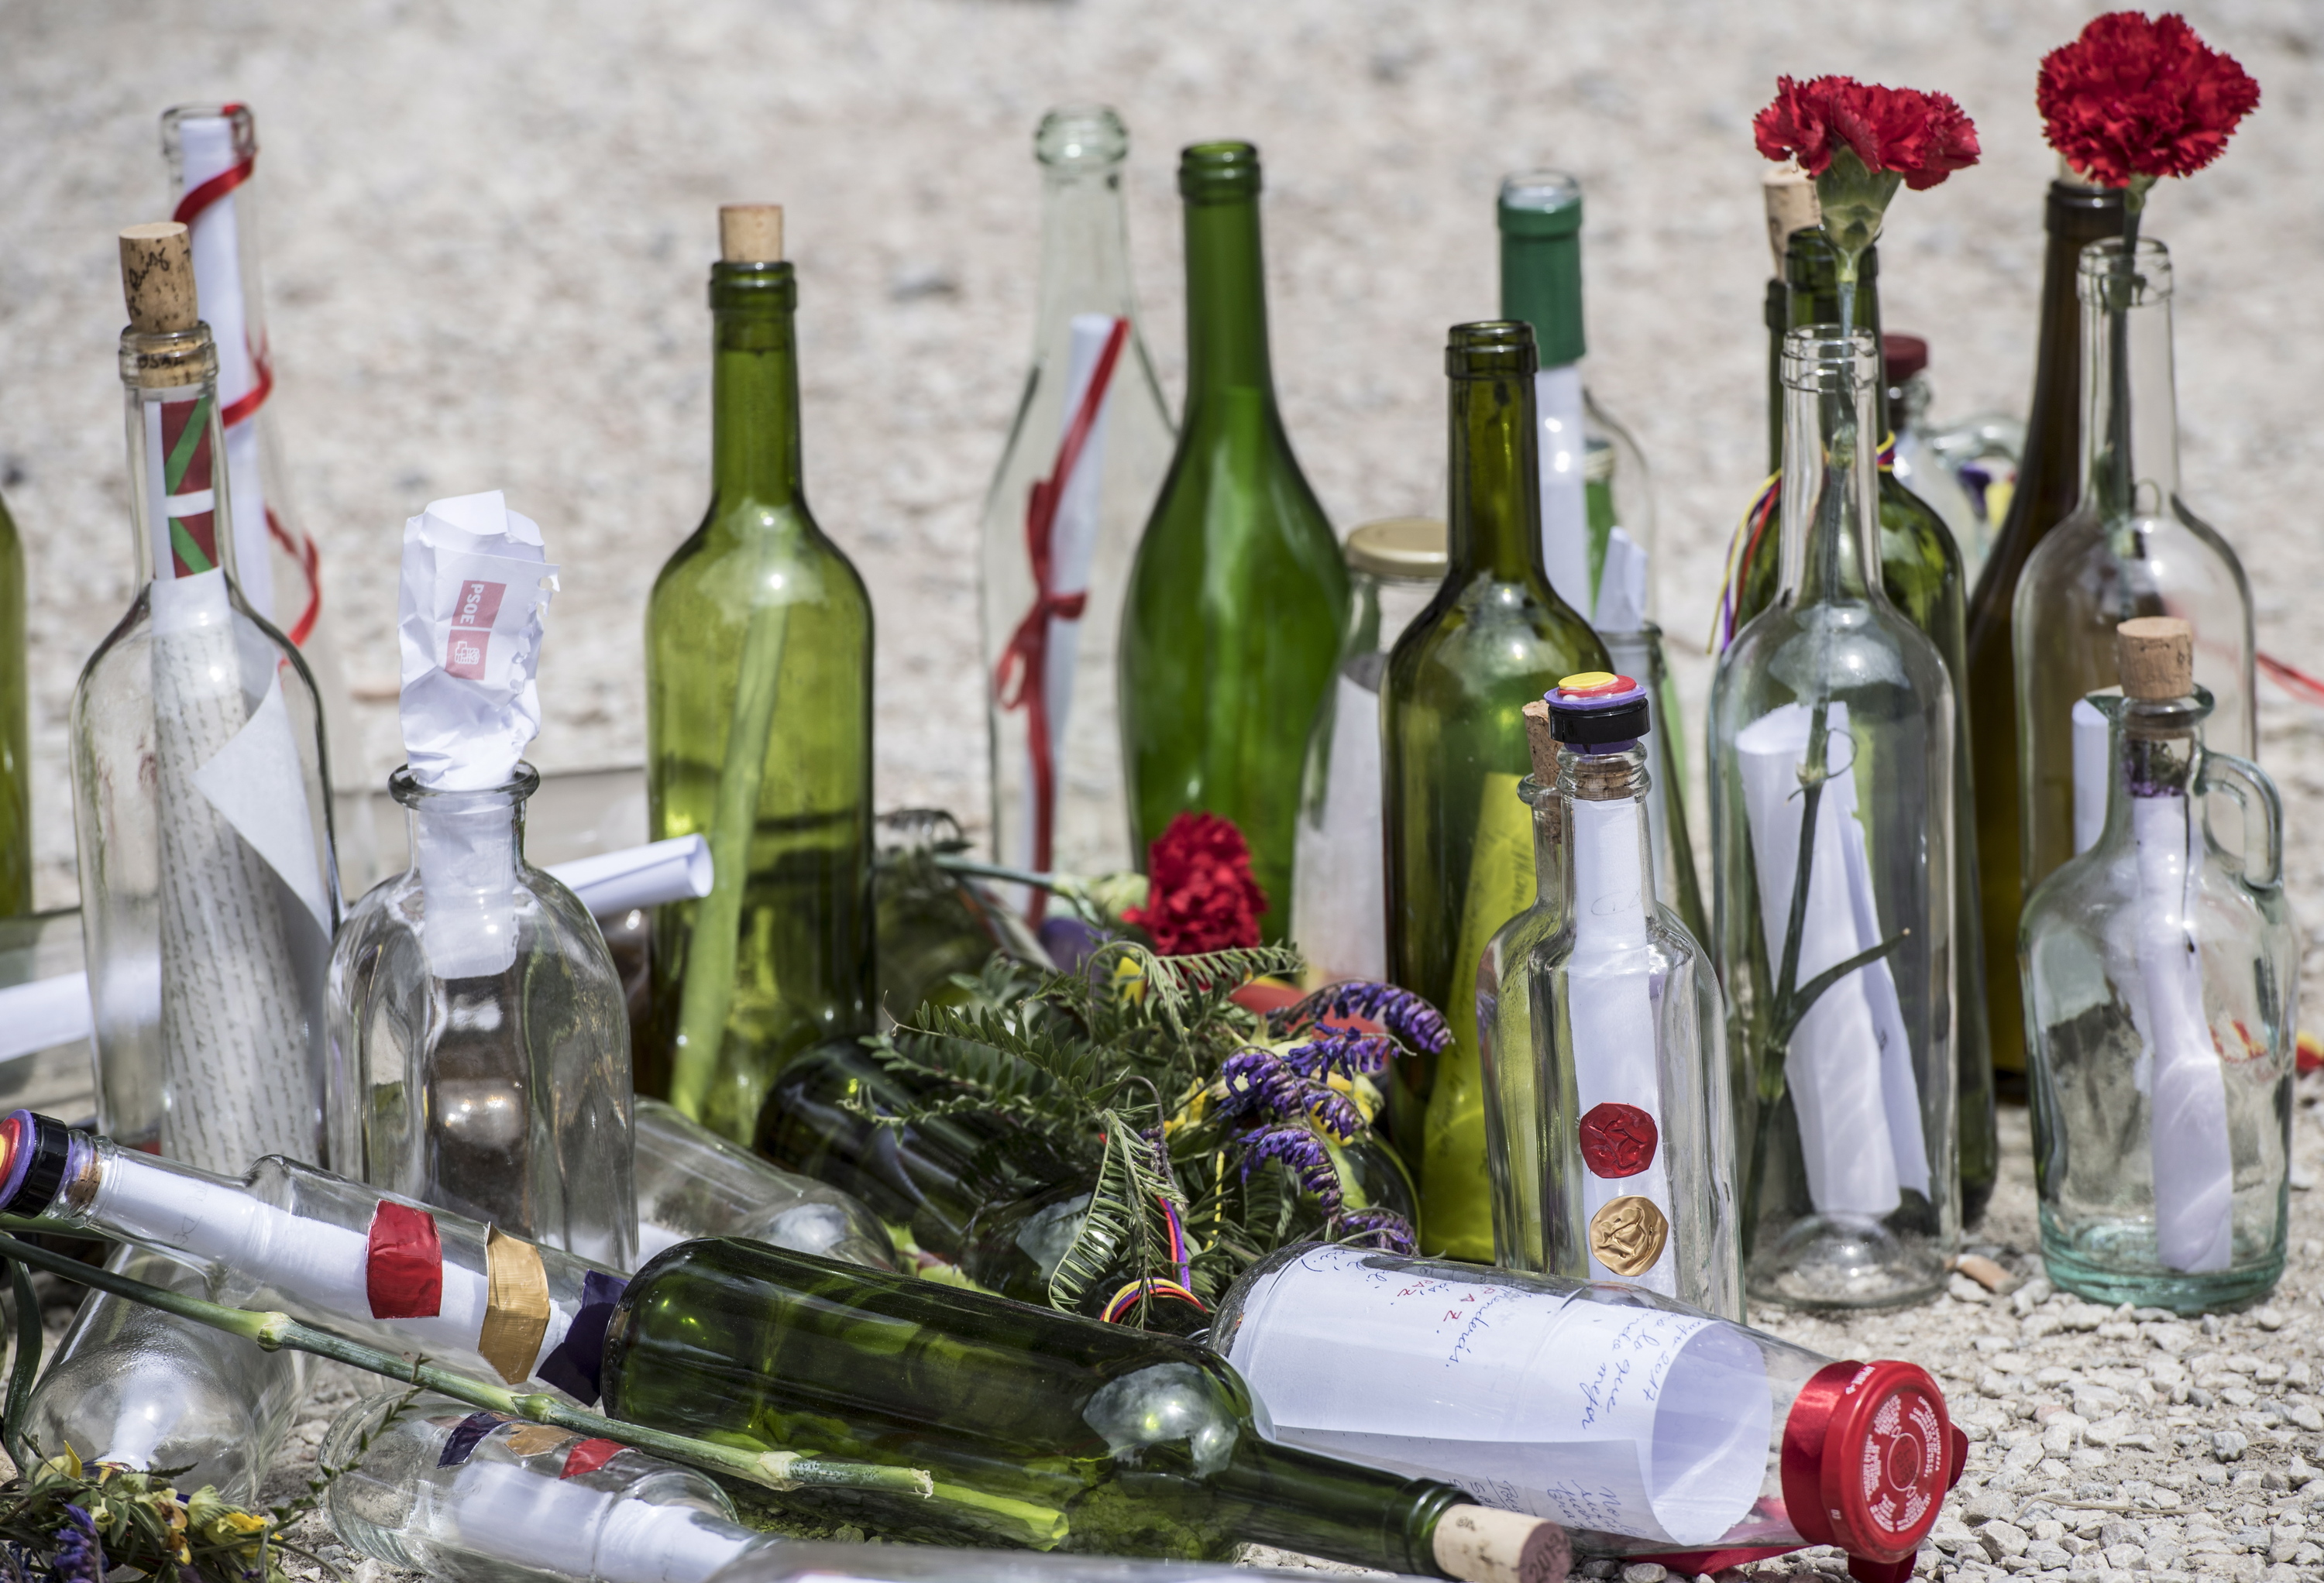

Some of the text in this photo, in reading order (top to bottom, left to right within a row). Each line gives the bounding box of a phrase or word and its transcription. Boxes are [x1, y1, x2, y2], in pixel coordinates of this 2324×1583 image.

[460, 583, 485, 624] PSOE
[1634, 1327, 1660, 1352] lo
[1581, 1362, 1607, 1430] mejor
[1643, 1350, 1669, 1402] 2017
